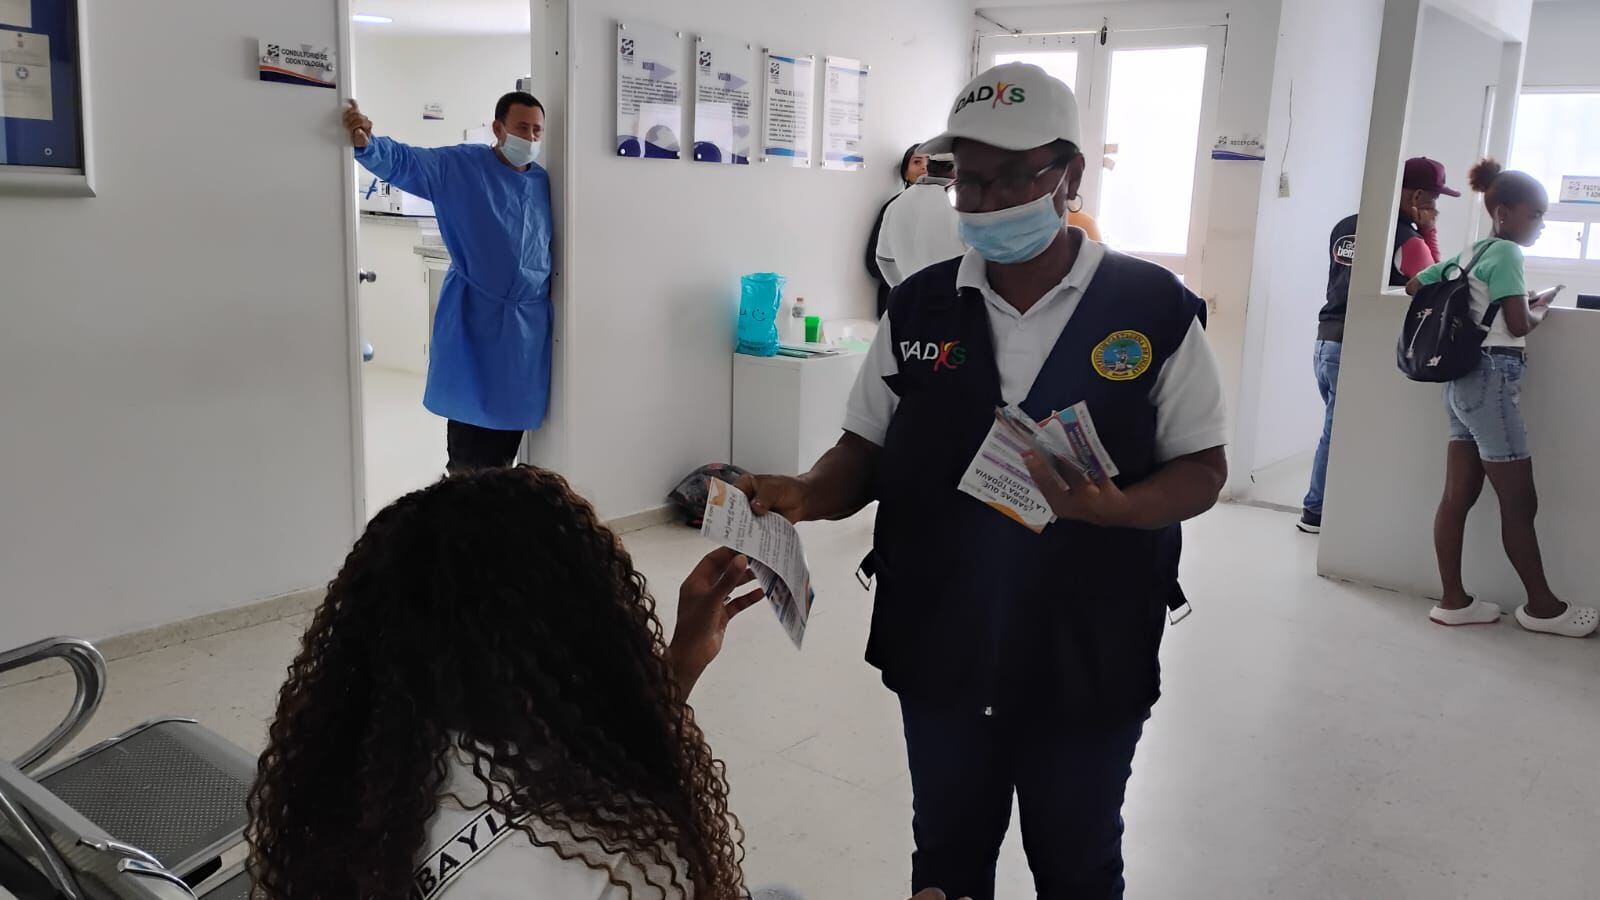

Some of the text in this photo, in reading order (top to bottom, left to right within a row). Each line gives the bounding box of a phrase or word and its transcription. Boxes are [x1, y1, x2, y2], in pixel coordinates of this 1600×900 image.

[281, 48, 328, 61] CONSULTORIO DE
[983, 481, 1000, 494] QUE
[1009, 487, 1035, 507] LEPRA
[1036, 503, 1047, 514] LA
